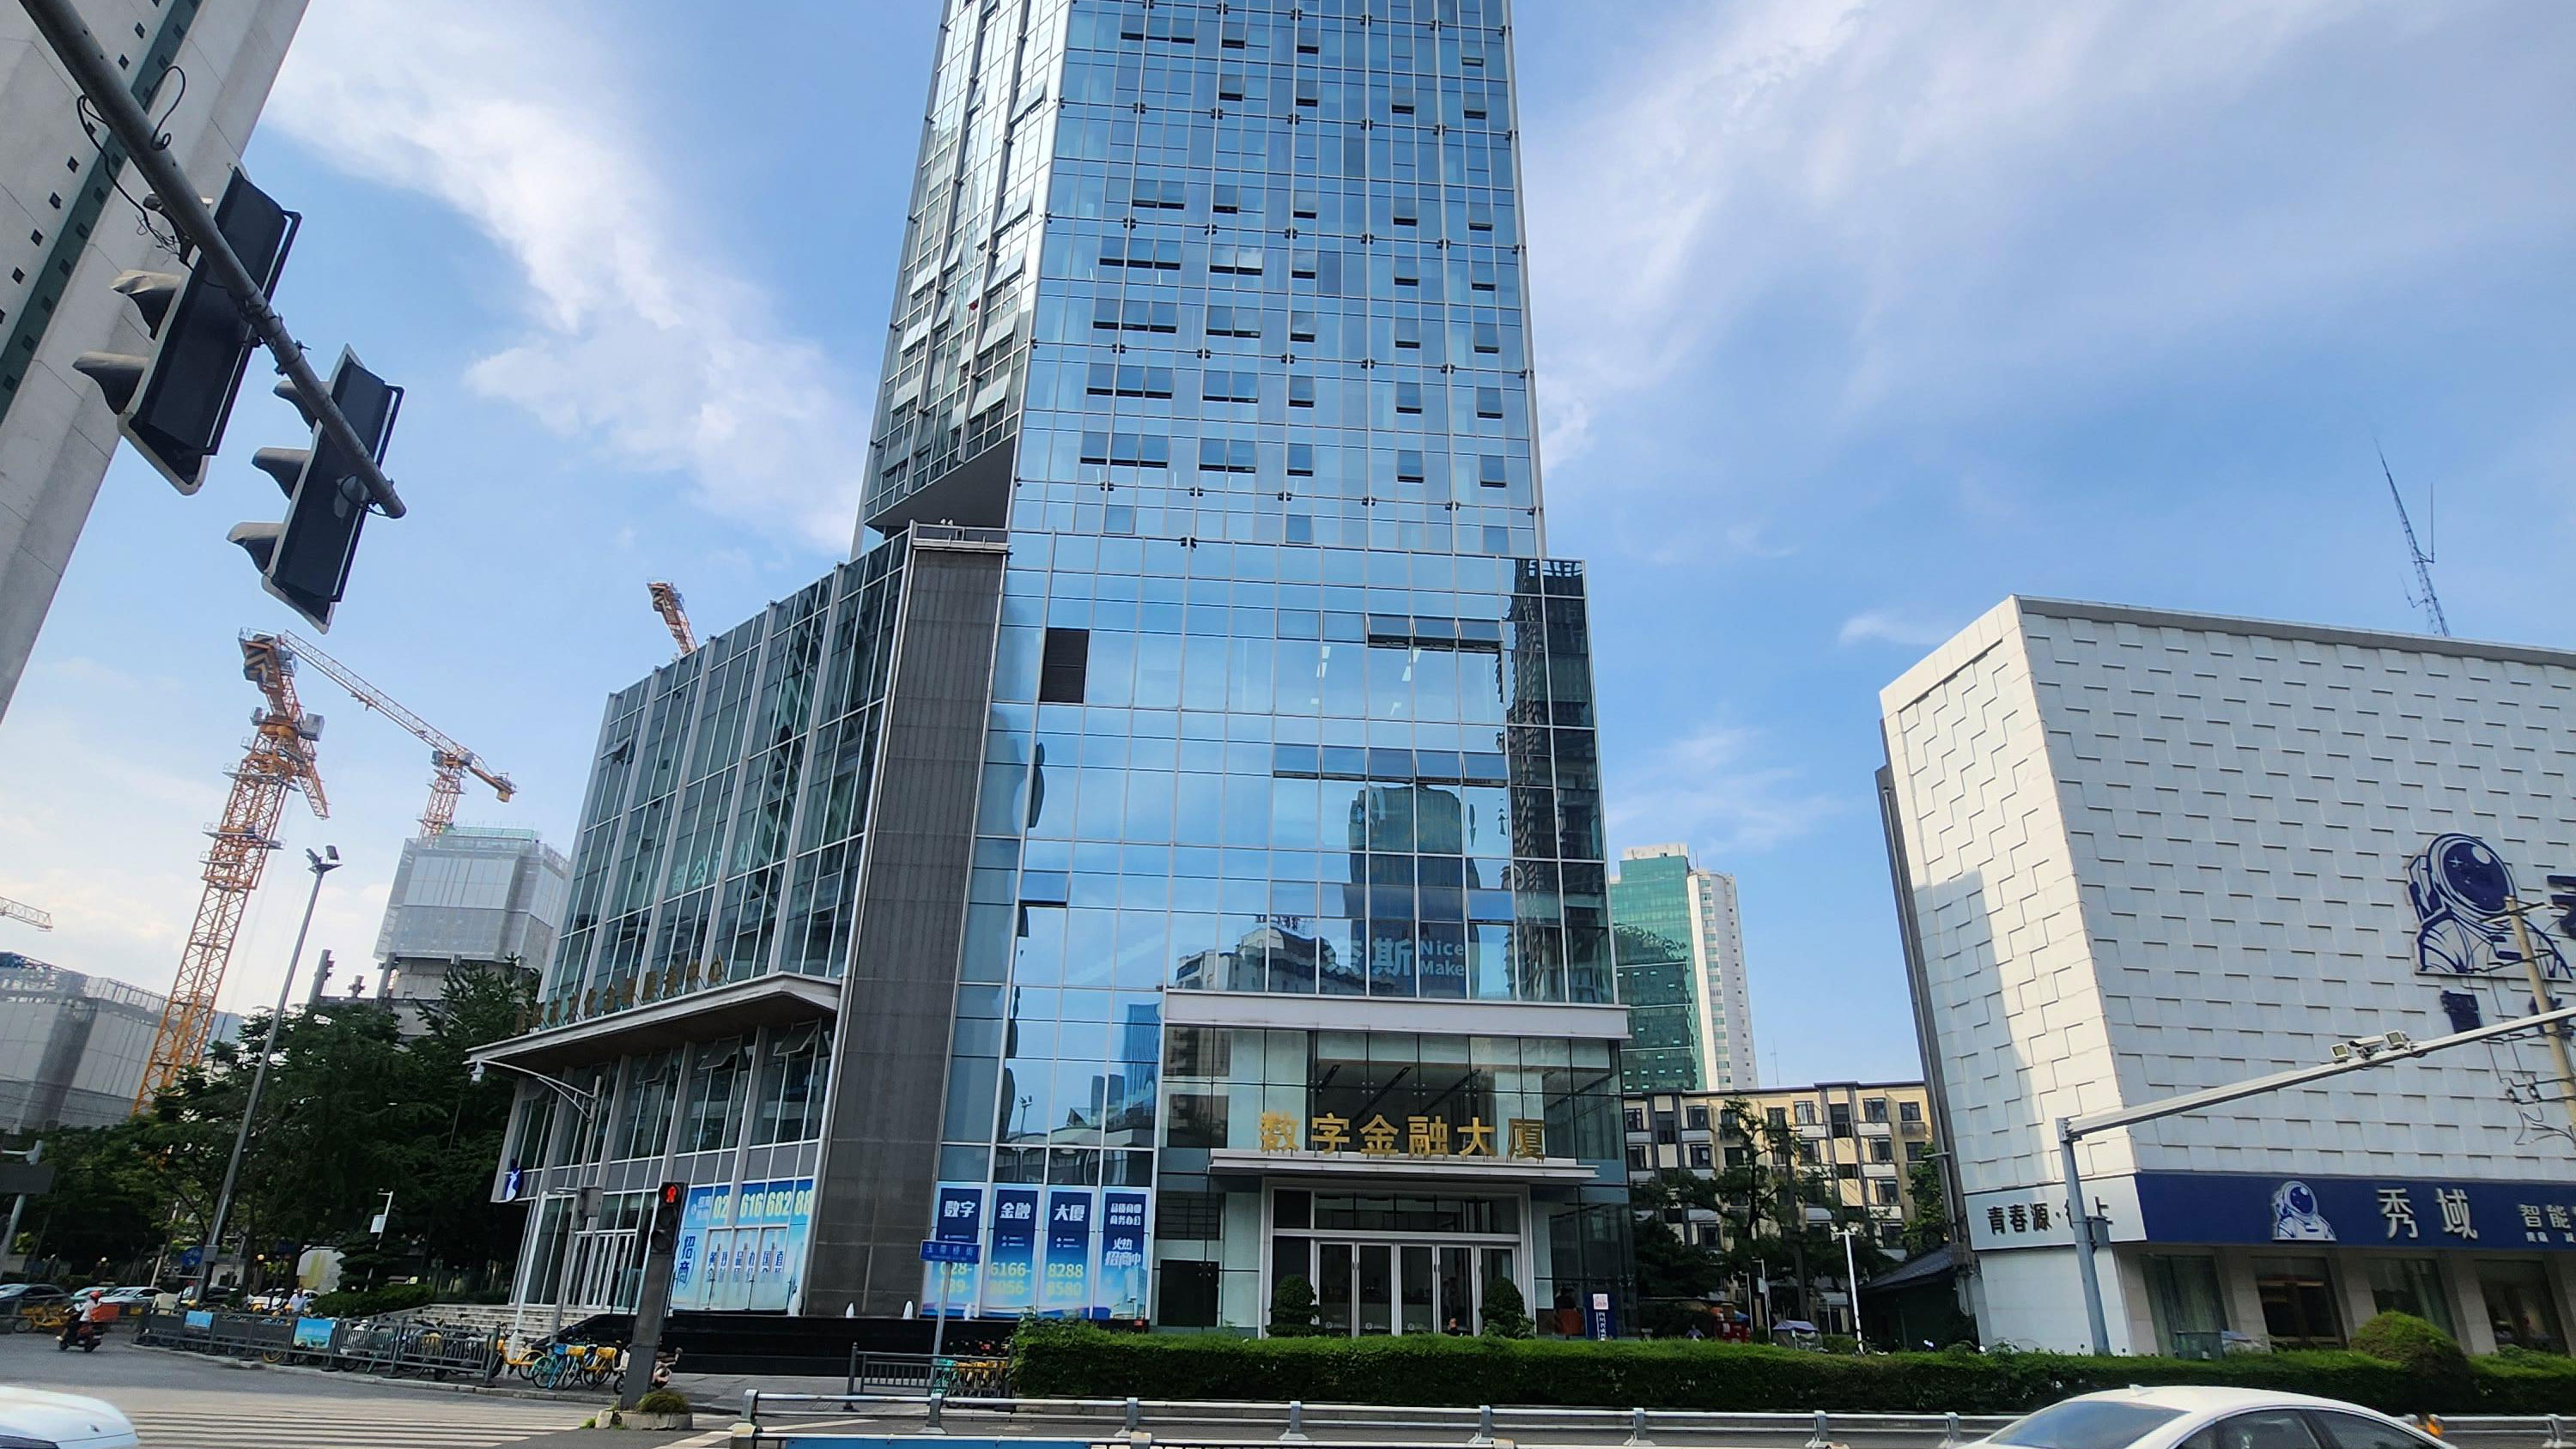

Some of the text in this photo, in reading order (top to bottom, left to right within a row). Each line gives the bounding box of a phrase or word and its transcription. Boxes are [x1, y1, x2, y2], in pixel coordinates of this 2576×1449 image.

[1420, 941, 1464, 956] Nice
[1420, 960, 1465, 976] Make
[1260, 1112, 1546, 1161] 数字金融大厦
[944, 1201, 1084, 1222] 数字 金融 大厦
[1987, 1197, 2114, 1235] 青春源·上
[2377, 1188, 2576, 1240] 秀域 智能
[1048, 1263, 1084, 1278] 8288
